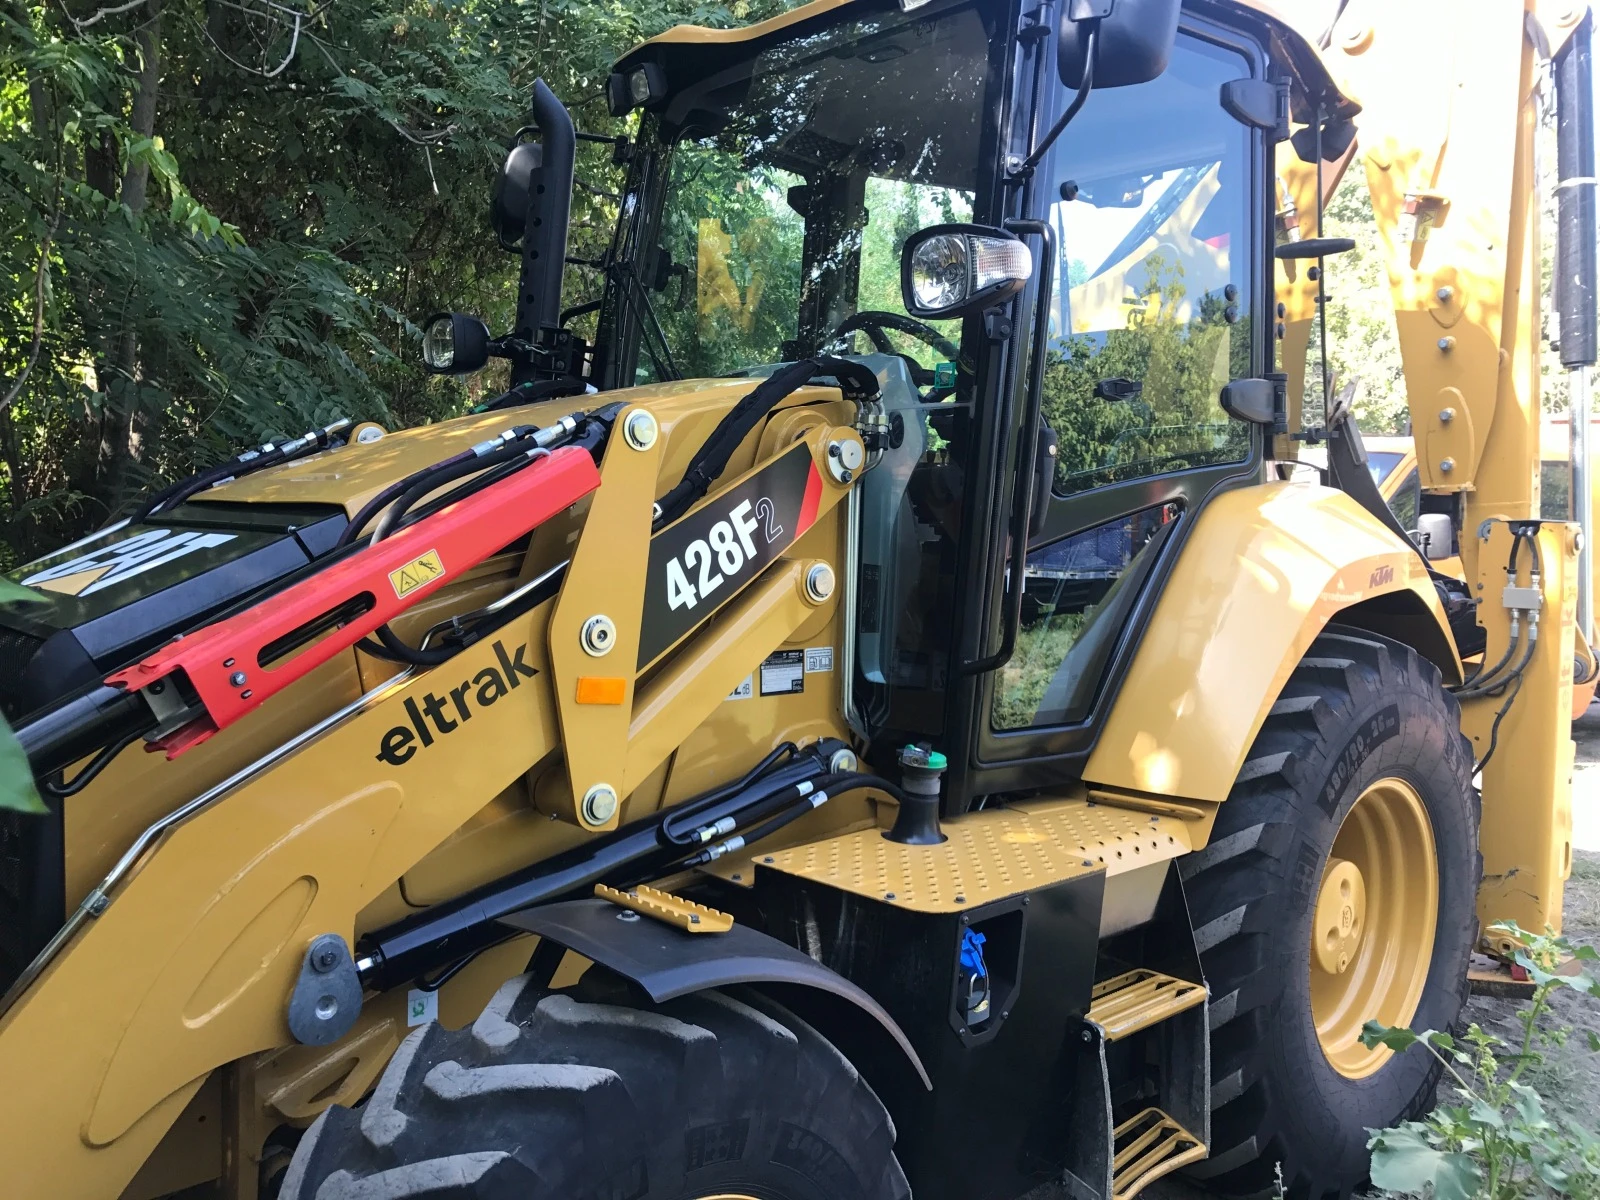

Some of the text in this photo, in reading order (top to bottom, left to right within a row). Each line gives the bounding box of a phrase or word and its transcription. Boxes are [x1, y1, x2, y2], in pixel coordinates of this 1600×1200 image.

[20, 528, 239, 598] CAT
[666, 497, 783, 611] 428F2
[1369, 565, 1394, 589] KTM
[375, 640, 540, 766] eltrak
